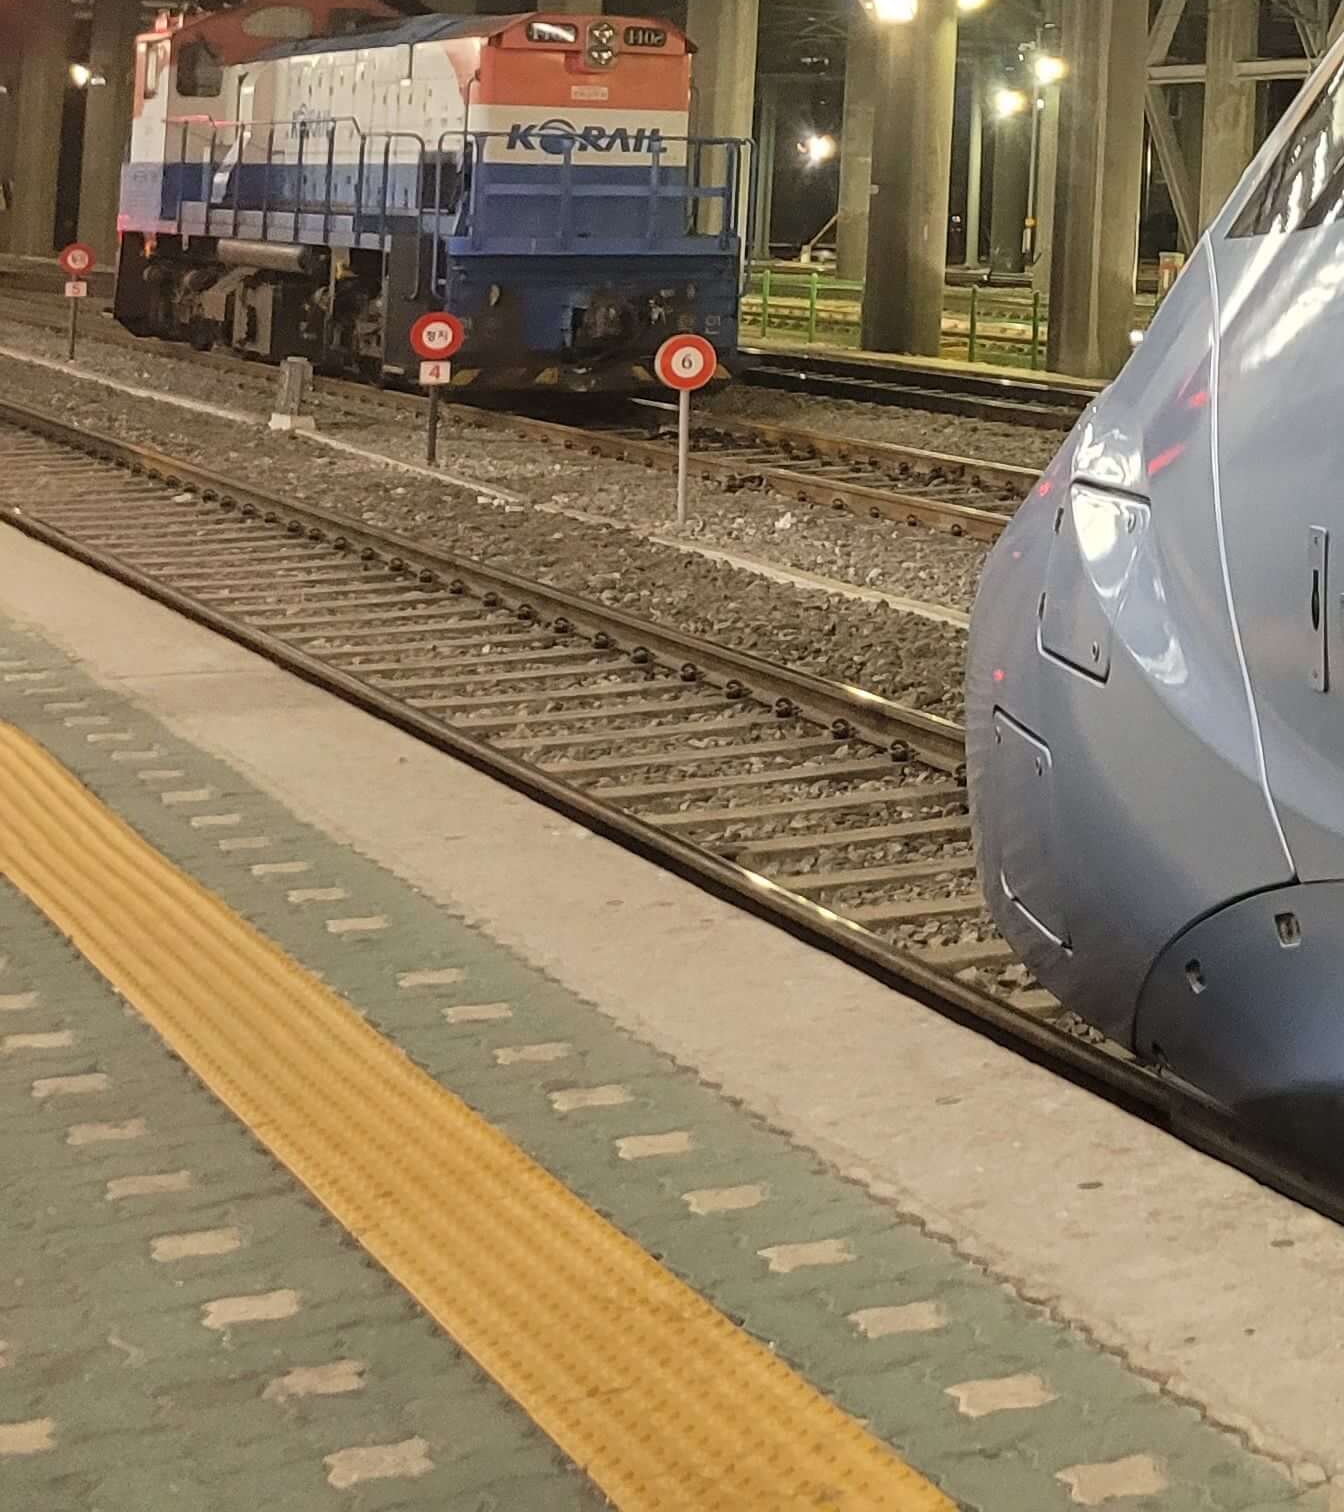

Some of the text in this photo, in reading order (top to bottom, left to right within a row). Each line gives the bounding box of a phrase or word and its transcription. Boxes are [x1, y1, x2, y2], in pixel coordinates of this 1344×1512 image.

[506, 119, 667, 155] KORAIL
[426, 330, 449, 343] 정지
[681, 352, 693, 370] 6
[428, 365, 441, 379] 4
